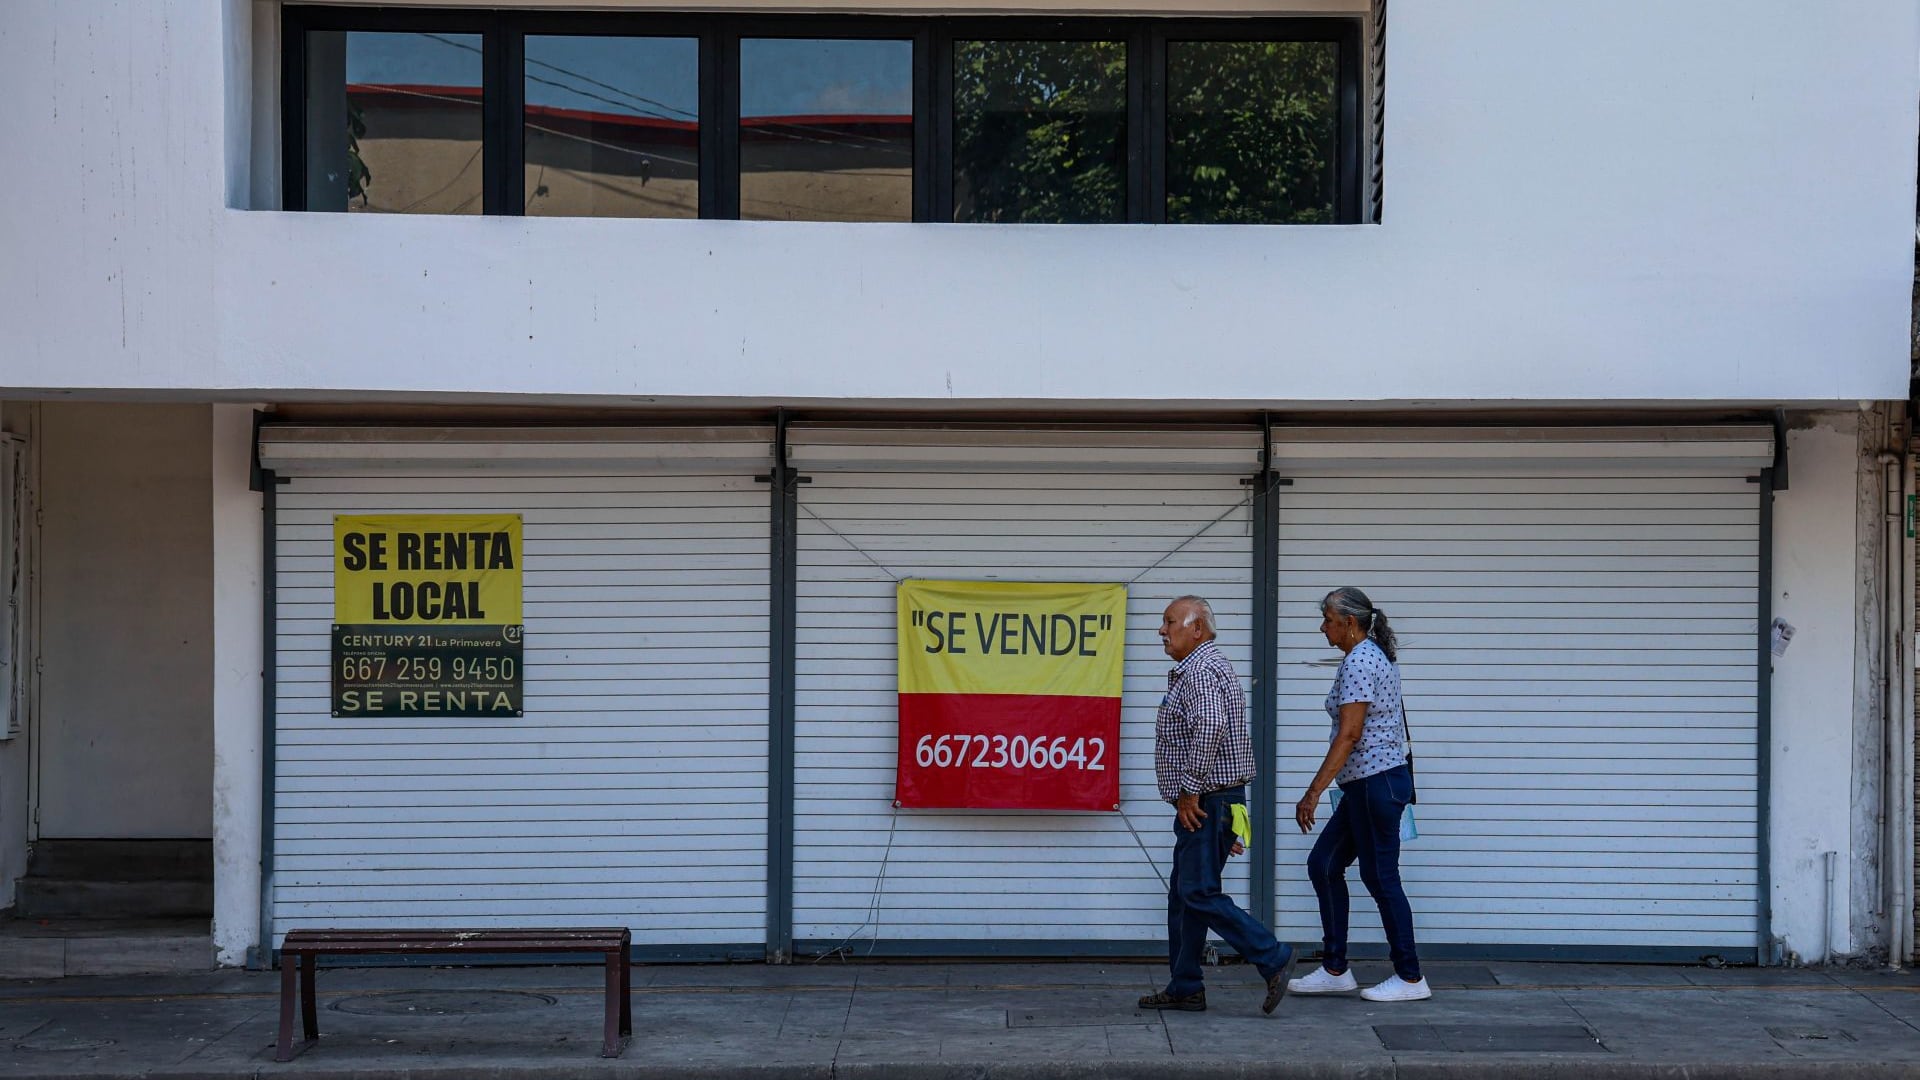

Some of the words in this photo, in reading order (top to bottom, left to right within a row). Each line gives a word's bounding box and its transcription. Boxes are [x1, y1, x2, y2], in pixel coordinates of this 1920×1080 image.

[343, 532, 387, 571] SE
[398, 532, 514, 570] RENTA
[373, 581, 485, 620] LOCAL
[342, 635, 415, 647] CENTURY
[418, 635, 431, 647] 21
[435, 639, 447, 647] La
[450, 638, 501, 647] Primavera
[912, 610, 966, 654] "SE
[975, 612, 1112, 657] VENDE"
[343, 657, 387, 681] 667
[397, 657, 441, 681] 259
[453, 657, 514, 681] 9450
[342, 691, 384, 711] SE
[400, 691, 513, 711] RENTA
[916, 734, 1105, 771] 6672306642
